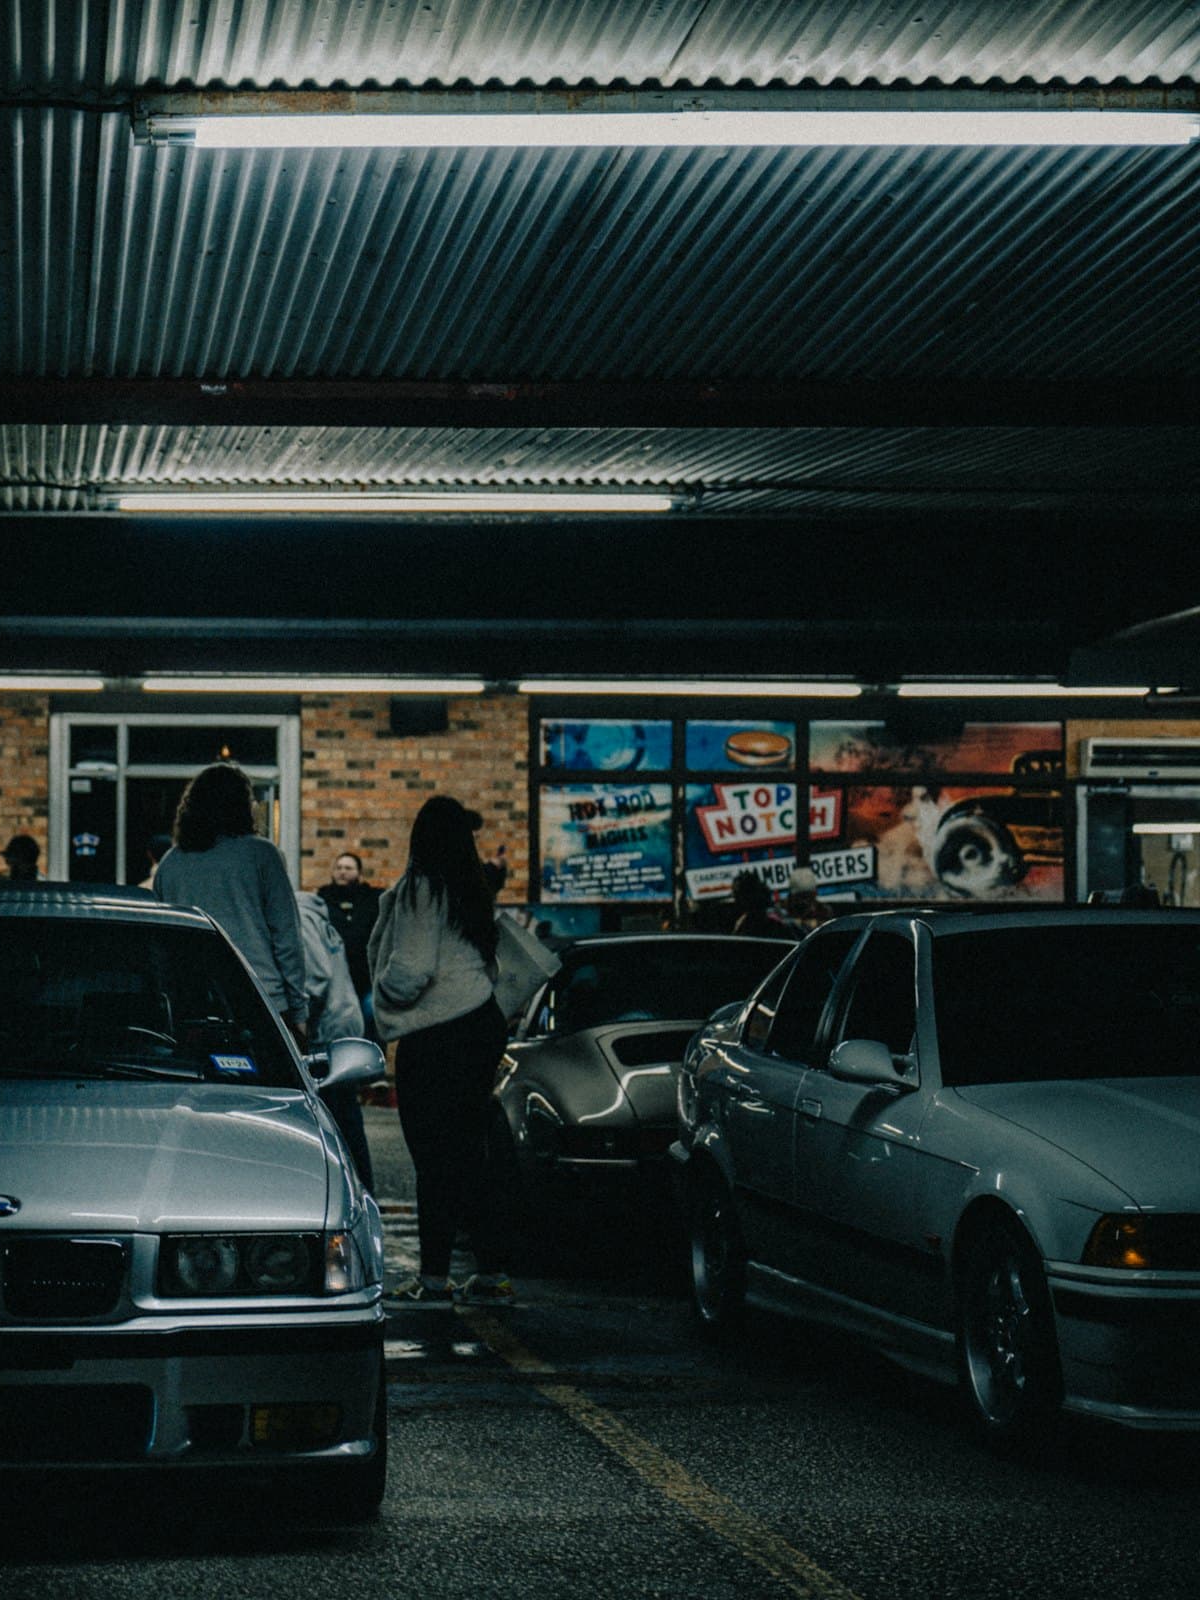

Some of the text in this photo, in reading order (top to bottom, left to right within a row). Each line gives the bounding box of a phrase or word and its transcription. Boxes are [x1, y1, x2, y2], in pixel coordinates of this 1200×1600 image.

[615, 790, 656, 817] ROD
[733, 784, 791, 809] TOP
[715, 807, 826, 838] NOTCH
